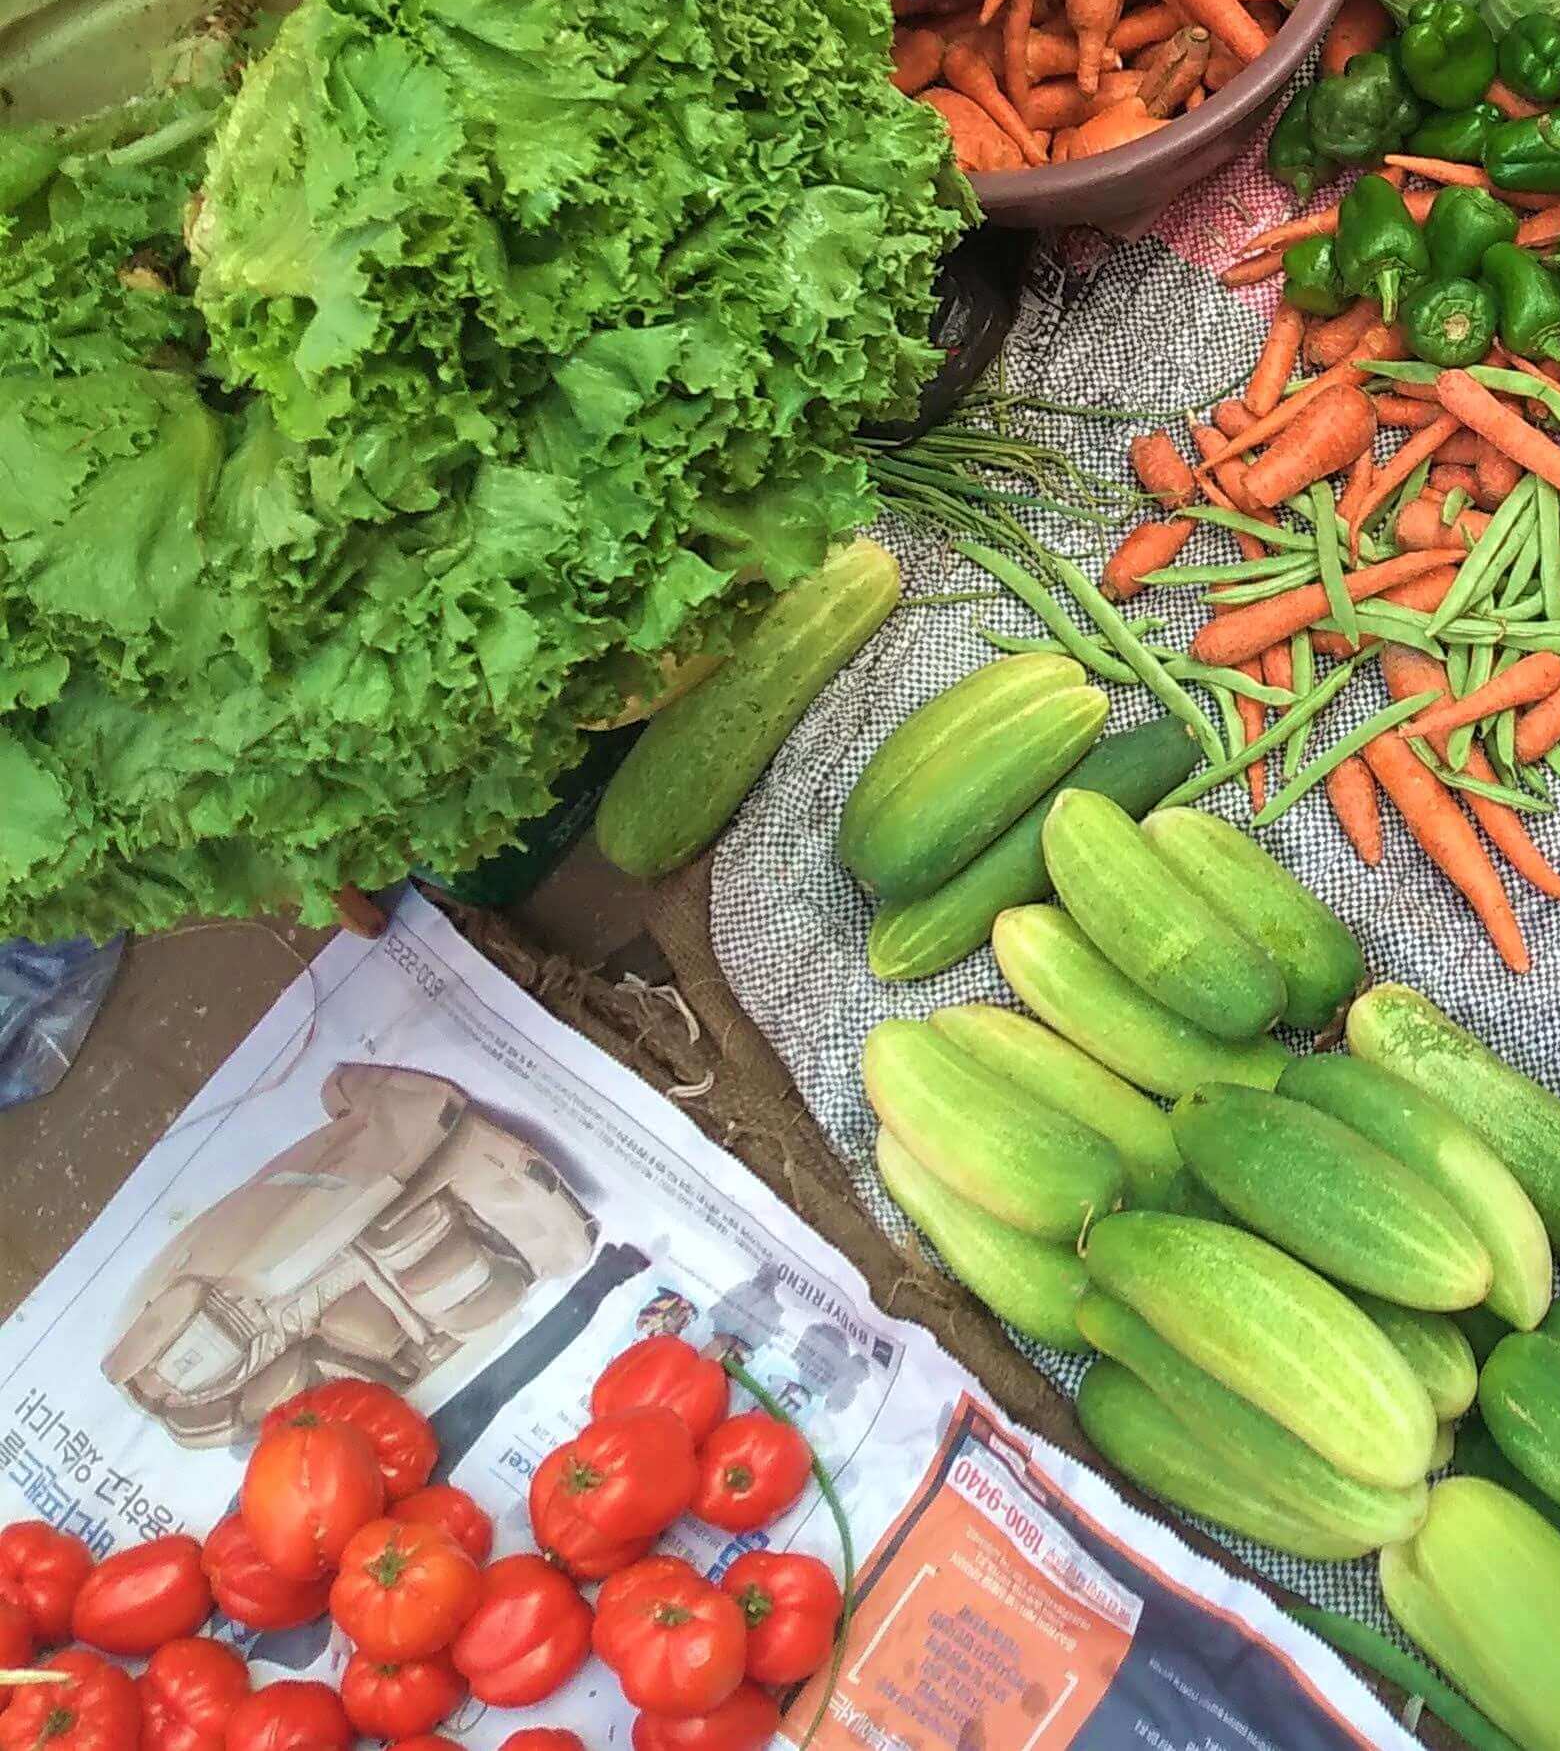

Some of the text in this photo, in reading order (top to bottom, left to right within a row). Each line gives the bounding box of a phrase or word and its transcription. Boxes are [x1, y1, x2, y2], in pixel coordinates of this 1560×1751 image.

[774, 1261, 870, 1347] BODYFRIEND
[14, 1386, 103, 1486] 있습니다!
[950, 1457, 1046, 1558] 1800-9440
